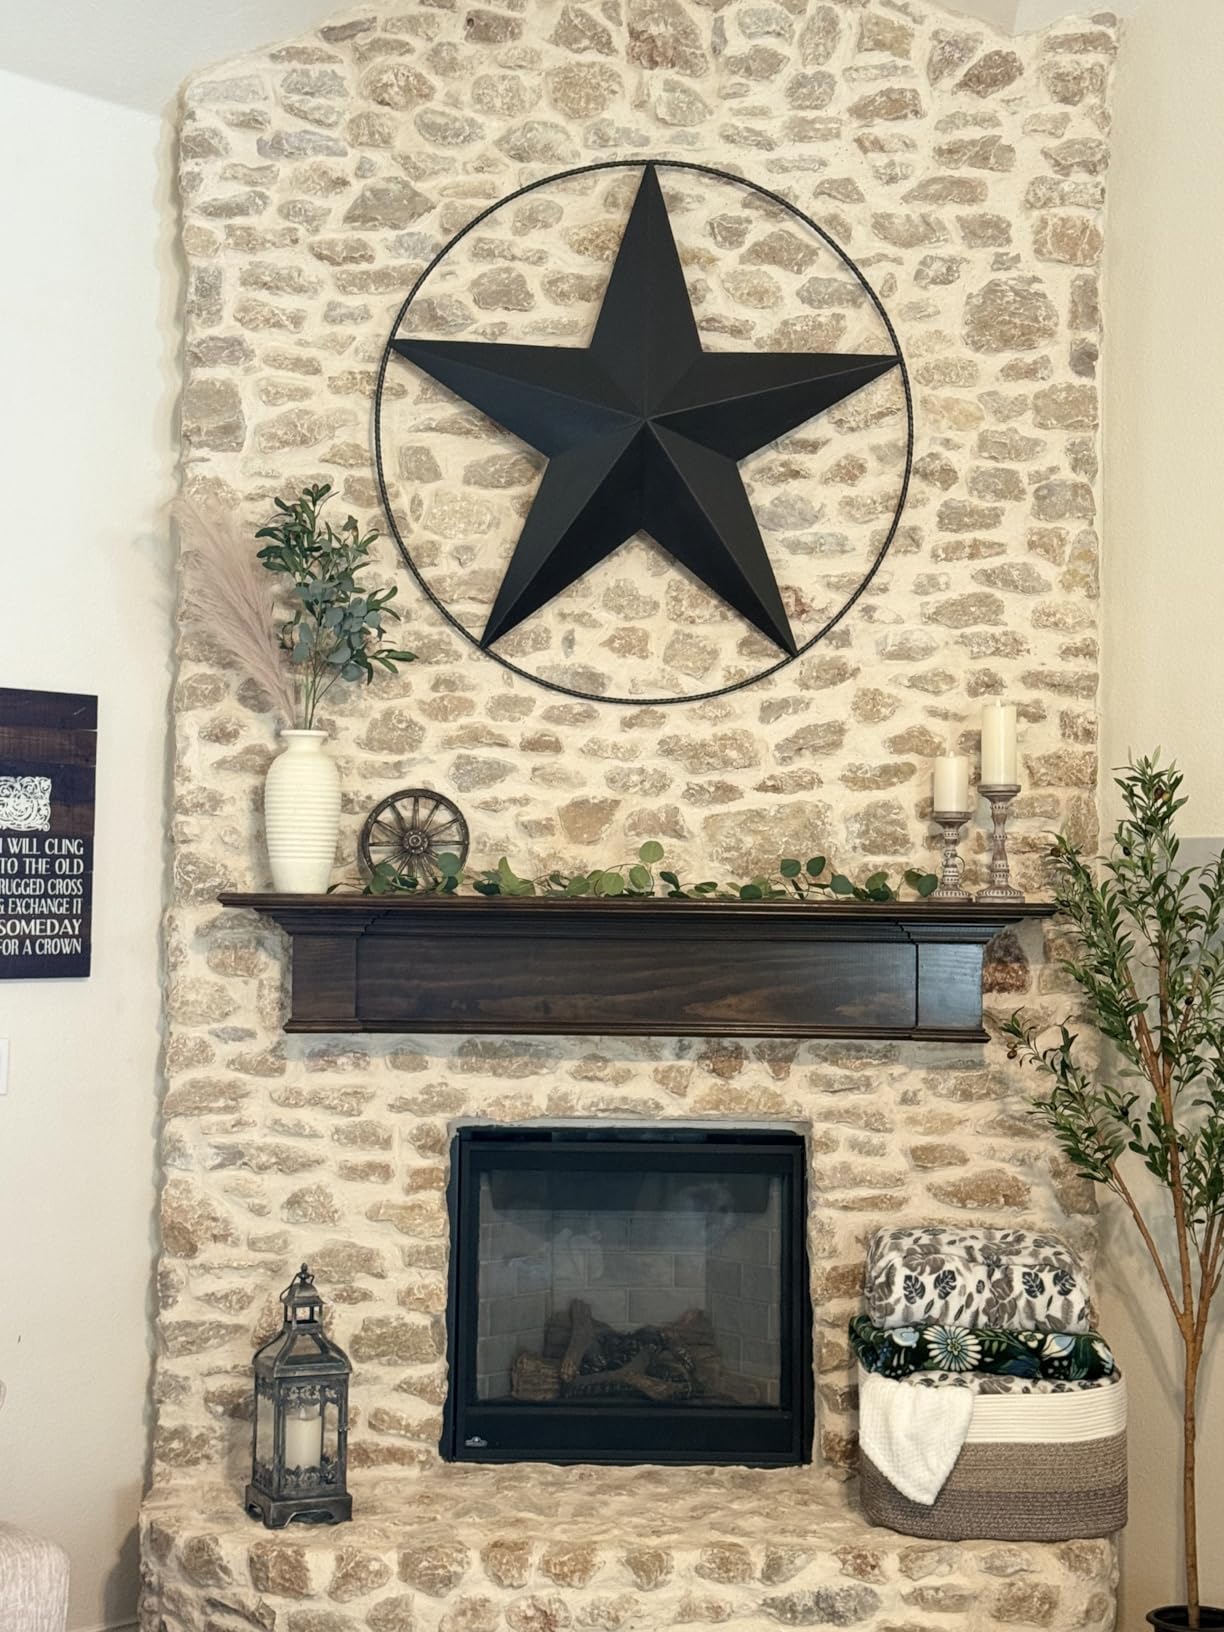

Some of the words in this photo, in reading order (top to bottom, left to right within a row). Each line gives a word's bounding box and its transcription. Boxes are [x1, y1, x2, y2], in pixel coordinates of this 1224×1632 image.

[7, 838, 40, 855] WILL
[45, 838, 84, 855] CLING
[0, 858, 18, 874] TO
[23, 858, 51, 875] THE
[55, 858, 84, 875] OLD
[0, 878, 45, 895] RUGGED
[48, 878, 83, 895] CROSS
[8, 898, 70, 915] EXCHANGE
[73, 898, 82, 915] IT
[0, 918, 82, 936] SOMEDAY
[23, 938, 32, 955] A
[35, 938, 82, 955] CROWN
